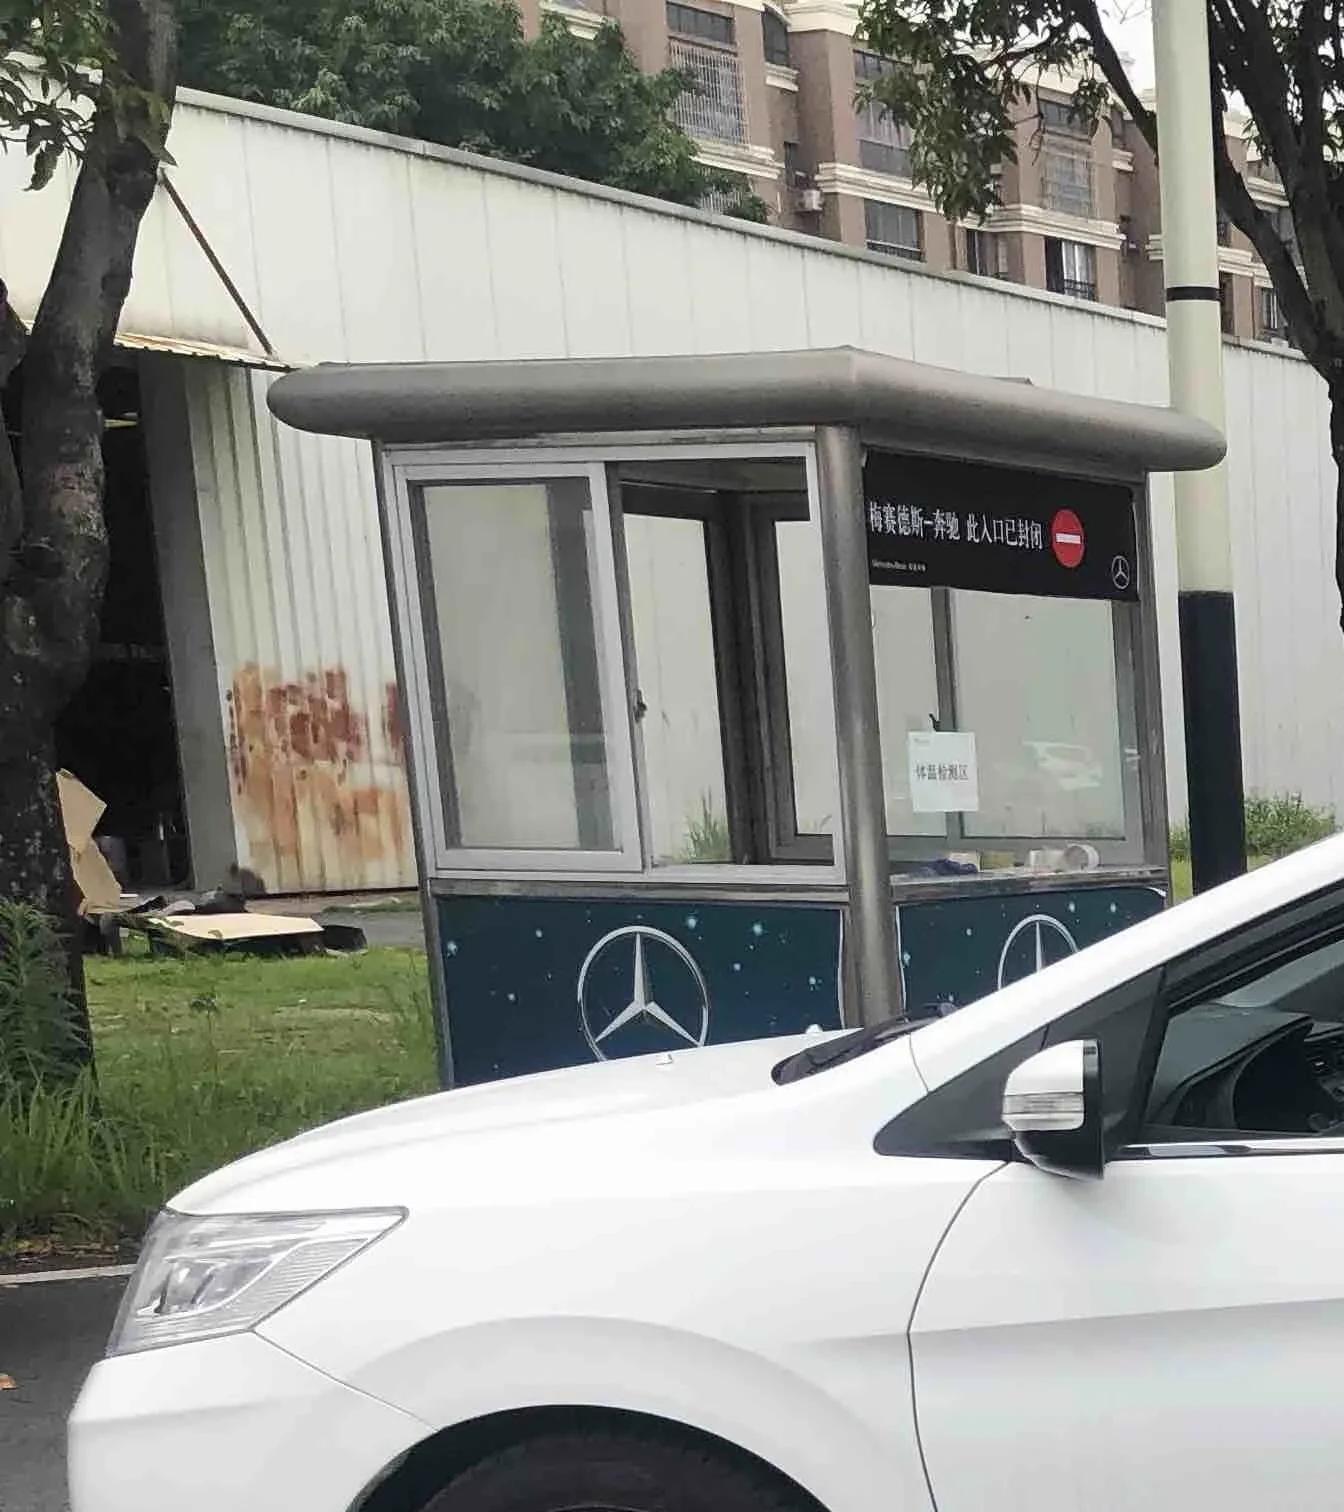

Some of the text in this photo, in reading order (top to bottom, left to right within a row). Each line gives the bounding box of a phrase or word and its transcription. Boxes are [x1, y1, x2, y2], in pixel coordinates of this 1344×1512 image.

[966, 512, 1044, 550] 此入口已封闭
